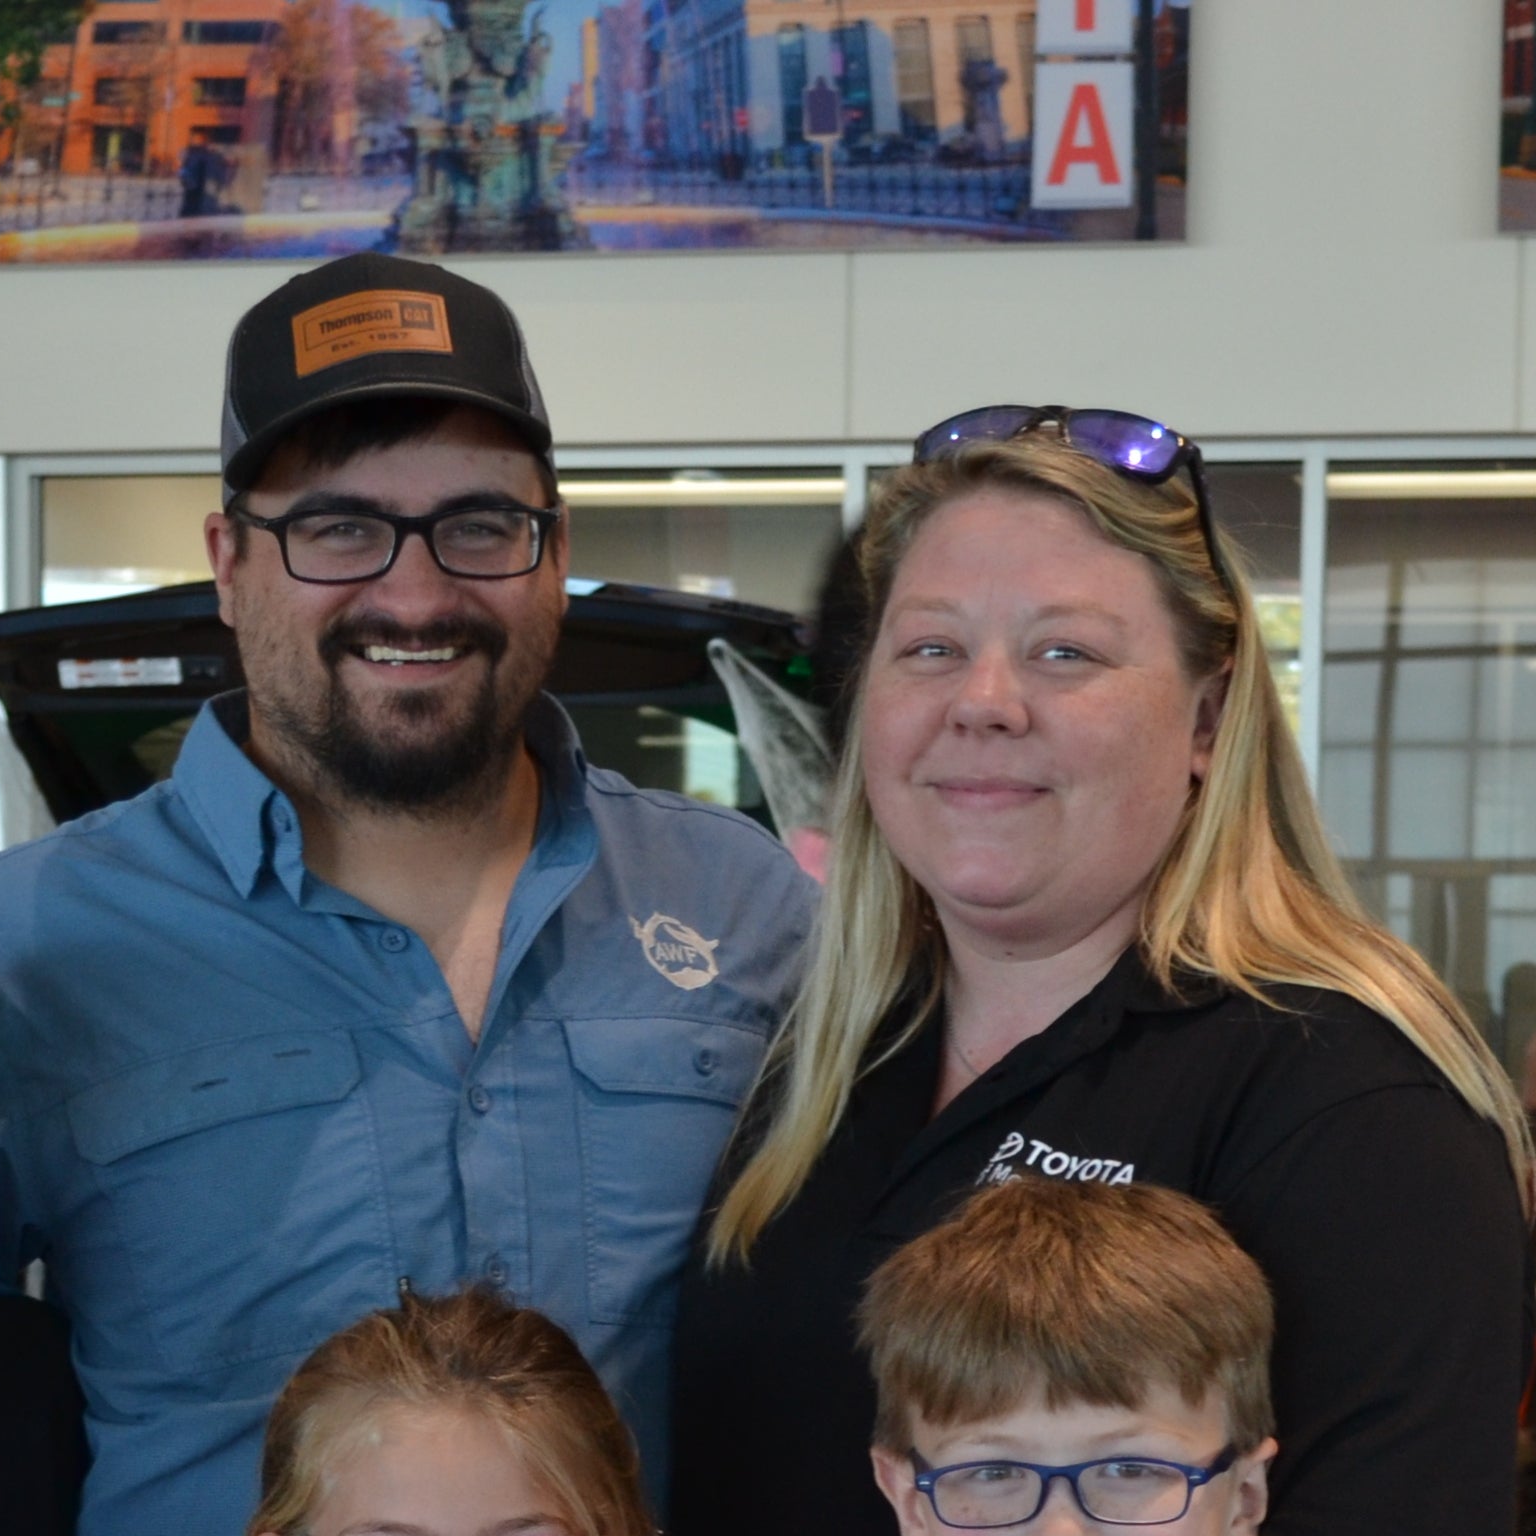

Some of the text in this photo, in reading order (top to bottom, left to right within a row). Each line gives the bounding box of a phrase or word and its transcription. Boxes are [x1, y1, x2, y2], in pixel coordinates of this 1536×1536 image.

[319, 307, 430, 334] Thompson CAT
[655, 942, 697, 963] AWF
[1025, 1139, 1135, 1186] TOYOTA
